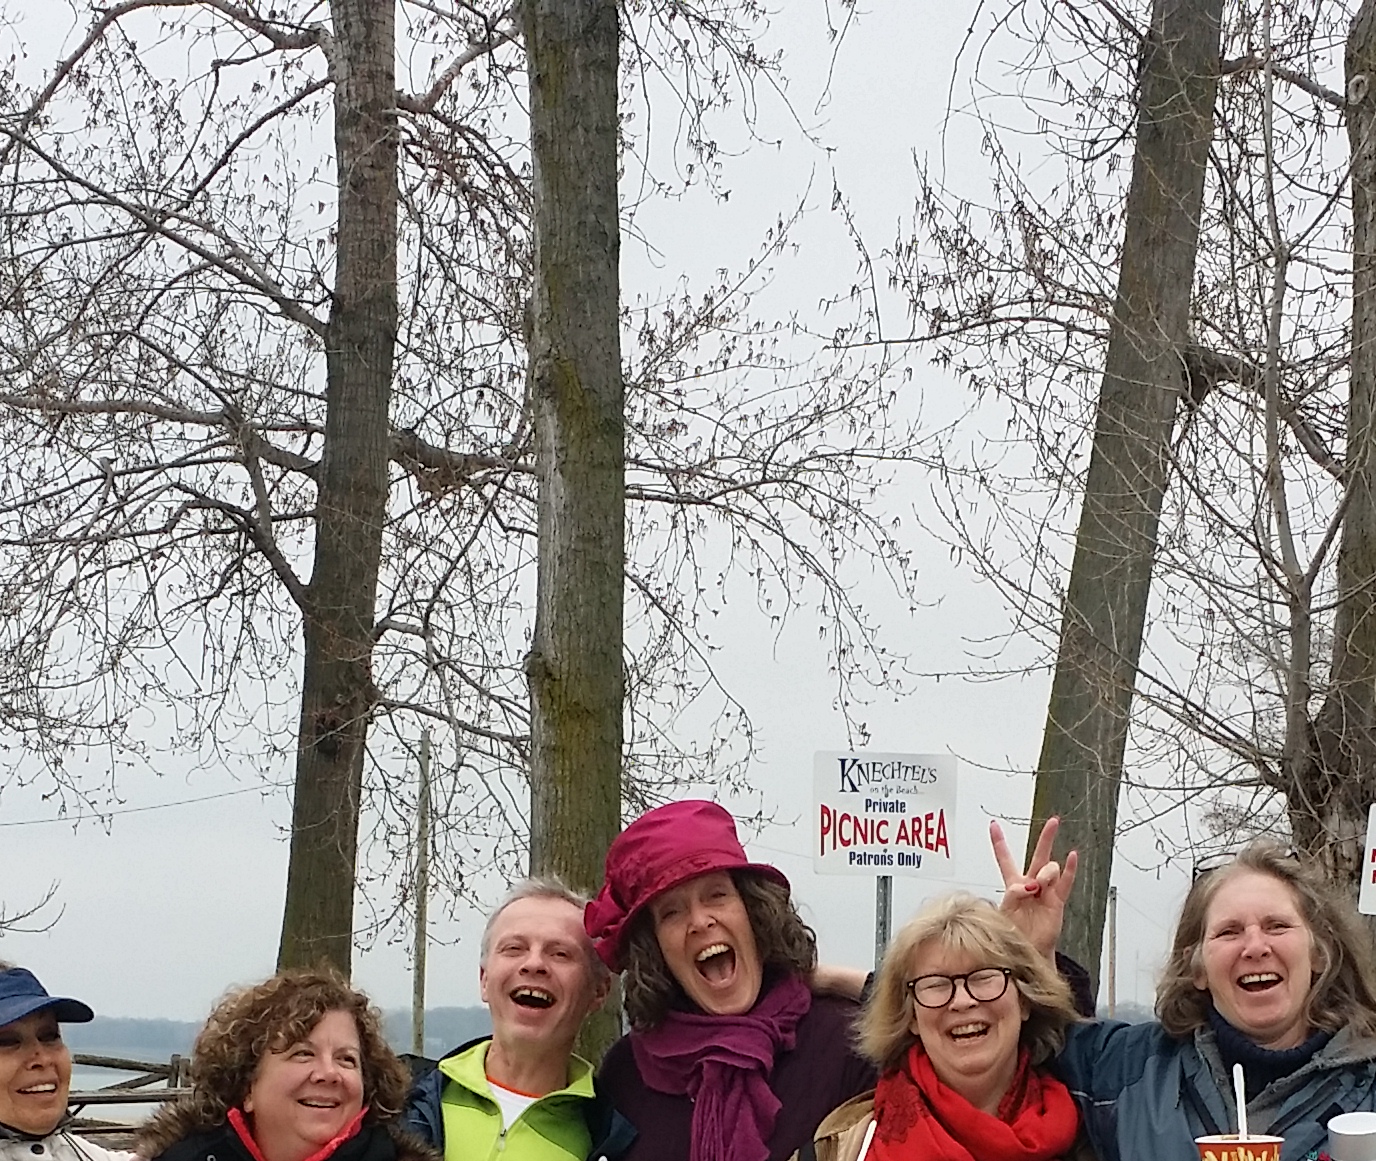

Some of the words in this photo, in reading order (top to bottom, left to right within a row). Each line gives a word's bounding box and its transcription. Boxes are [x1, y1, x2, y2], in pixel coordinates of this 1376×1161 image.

[837, 758, 937, 793] KNECHTEL'S
[864, 798, 906, 813] Private
[820, 804, 889, 857] PICNIC
[895, 808, 950, 859] AREA
[849, 851, 893, 866] Patrons
[897, 852, 922, 868] Only
